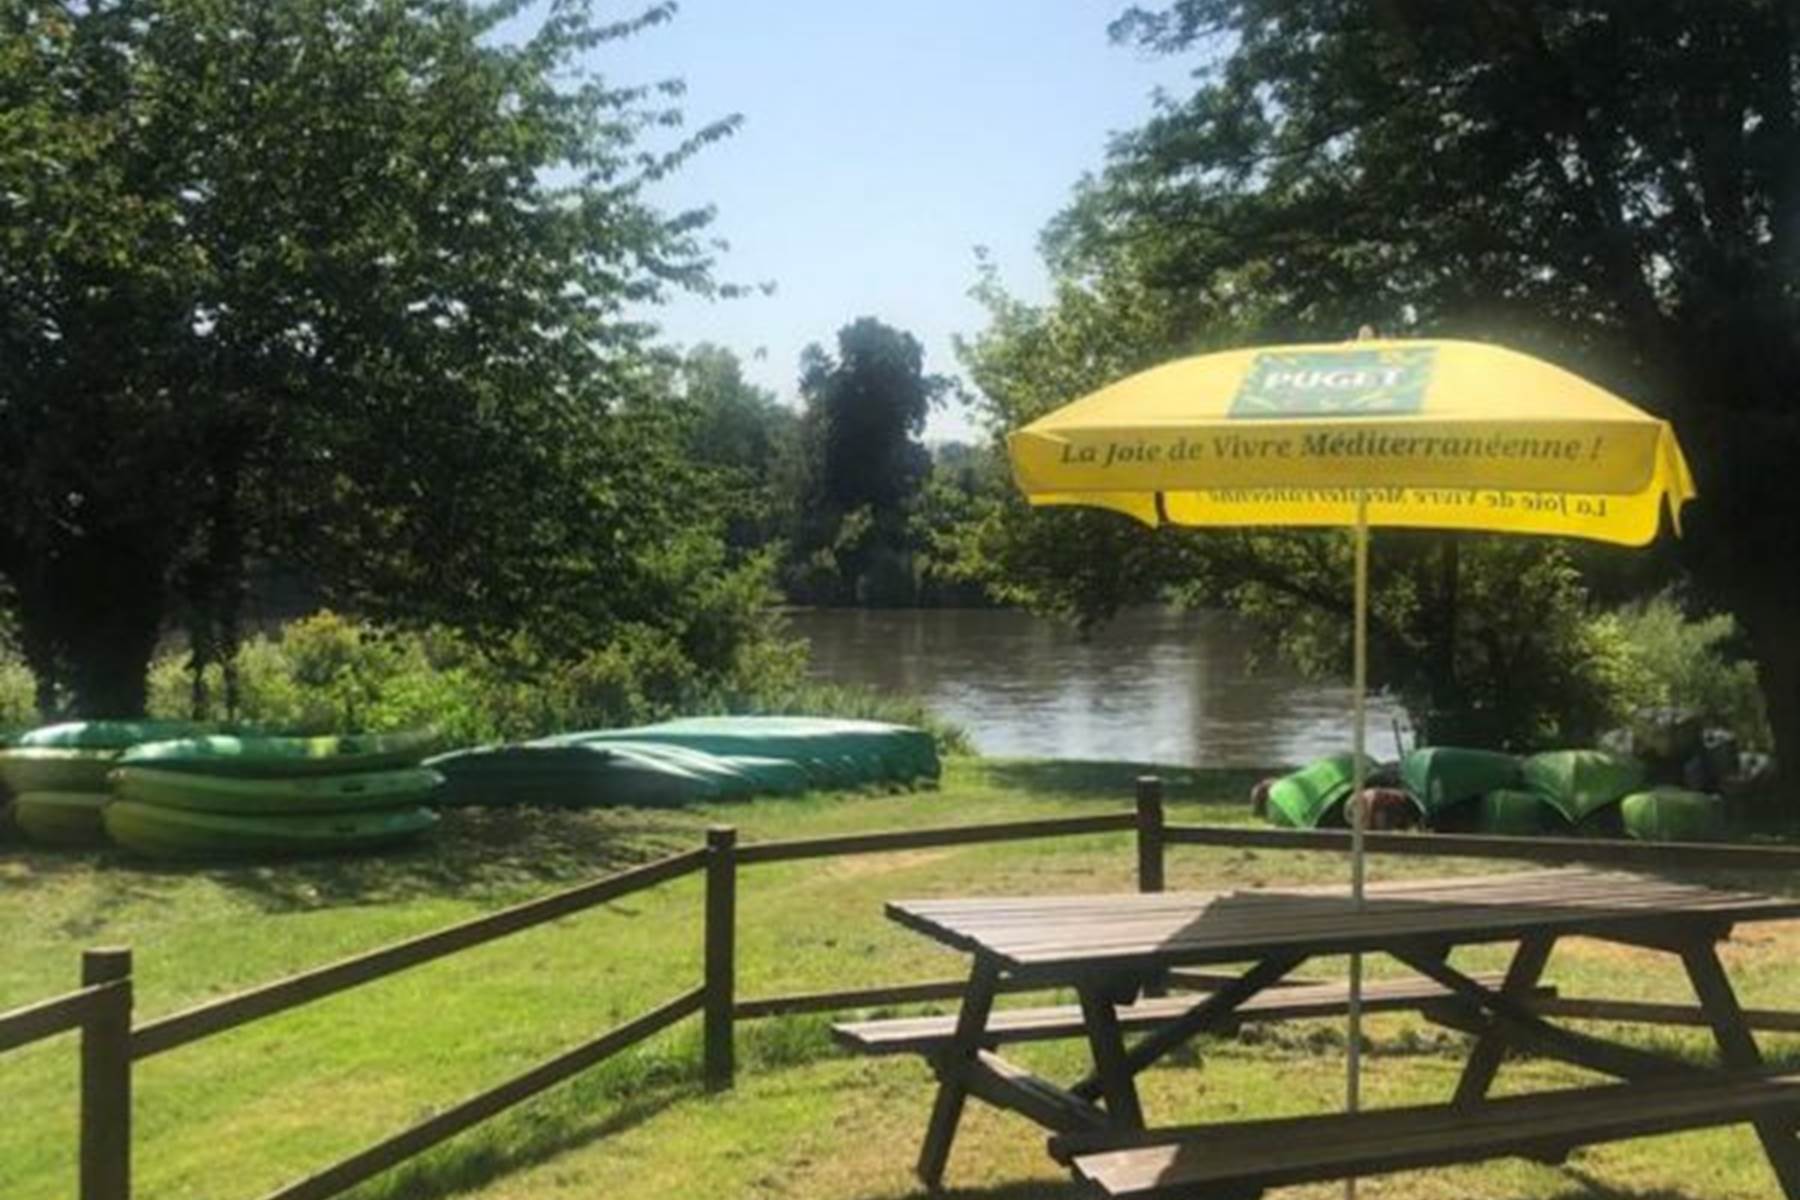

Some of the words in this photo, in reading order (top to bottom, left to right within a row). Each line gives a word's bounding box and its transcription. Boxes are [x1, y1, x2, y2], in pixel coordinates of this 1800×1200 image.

[1262, 368, 1406, 389] PUGET
[1061, 442, 1096, 463] La
[1103, 440, 1161, 467] Joie
[1169, 436, 1201, 460] de
[1212, 434, 1292, 458] Vivre
[1301, 432, 1582, 460] Méditerranéenne
